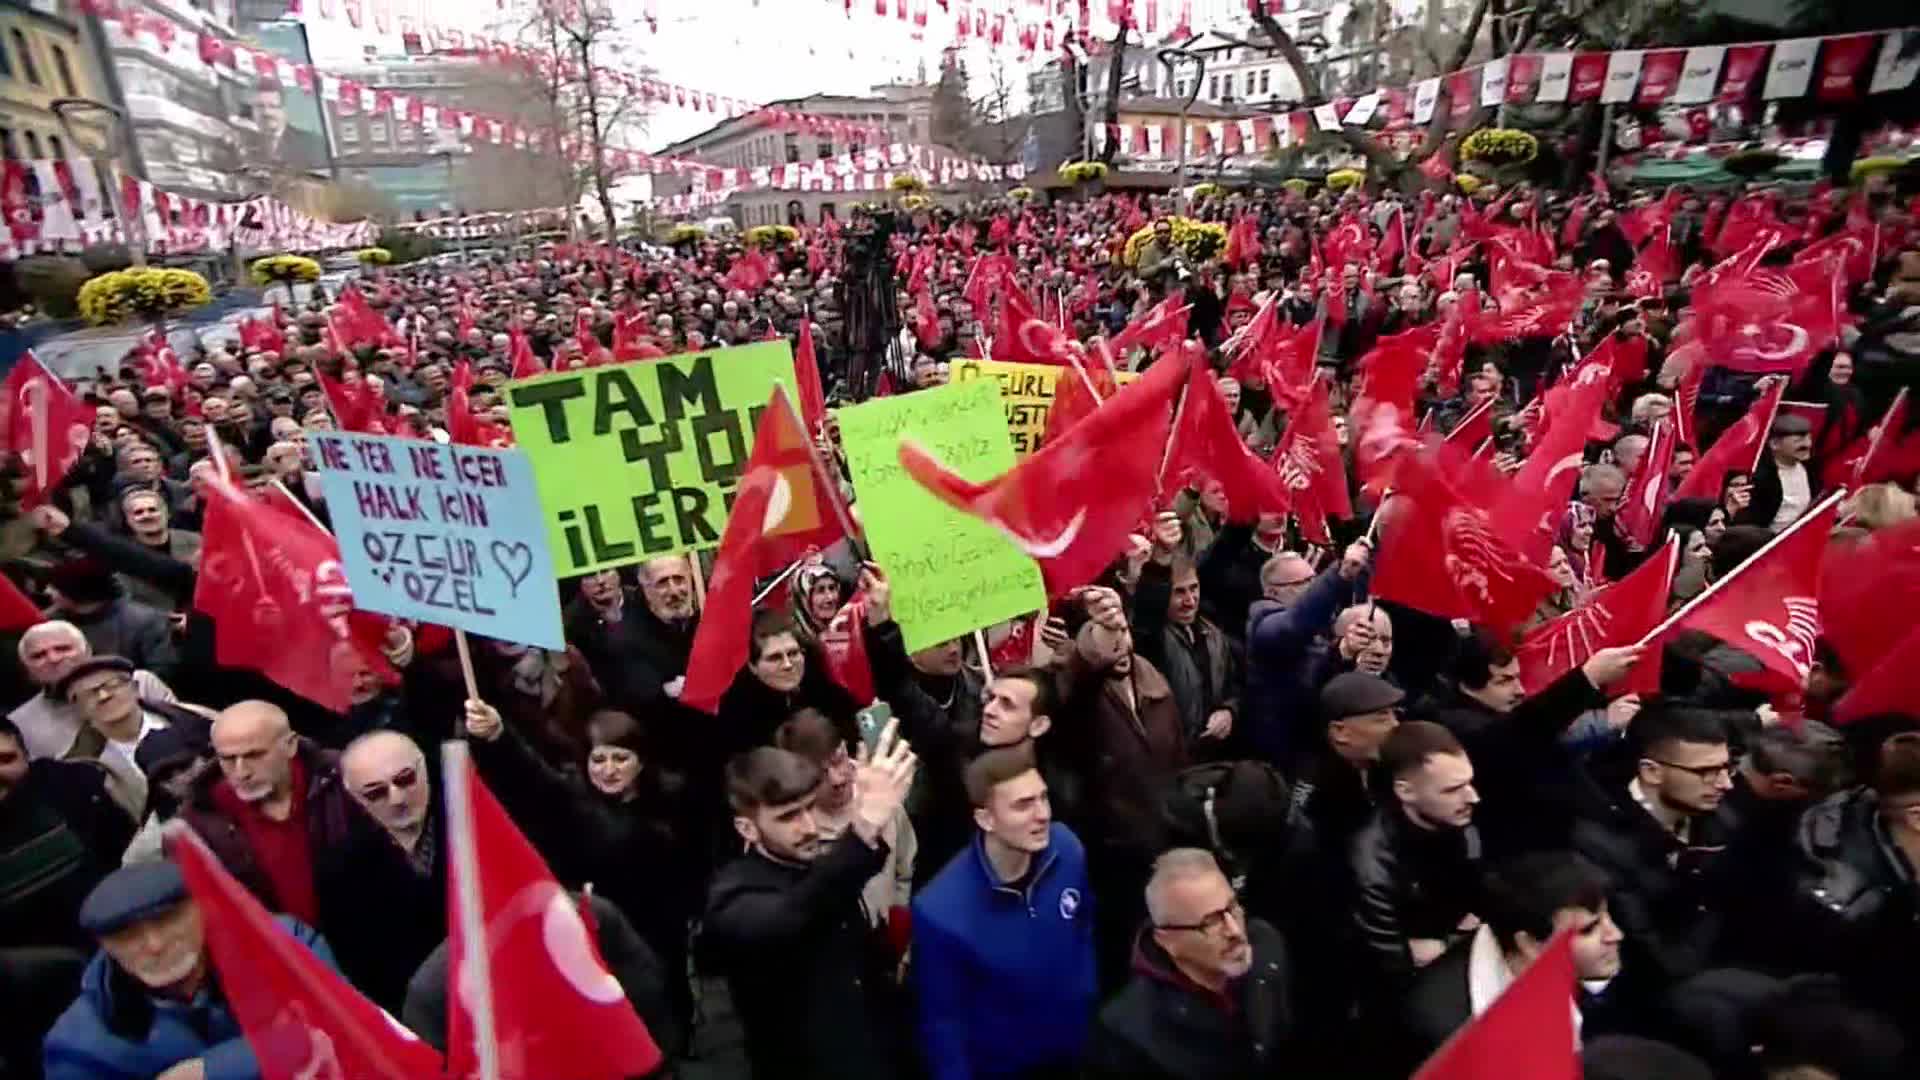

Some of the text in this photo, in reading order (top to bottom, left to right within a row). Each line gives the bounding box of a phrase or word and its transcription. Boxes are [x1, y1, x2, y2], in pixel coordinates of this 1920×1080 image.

[510, 357, 723, 443] TAM
[317, 437, 350, 471] NE
[352, 439, 395, 473] YER
[408, 446, 446, 480] NE
[619, 404, 767, 493] YO
[354, 480, 429, 521] HALK
